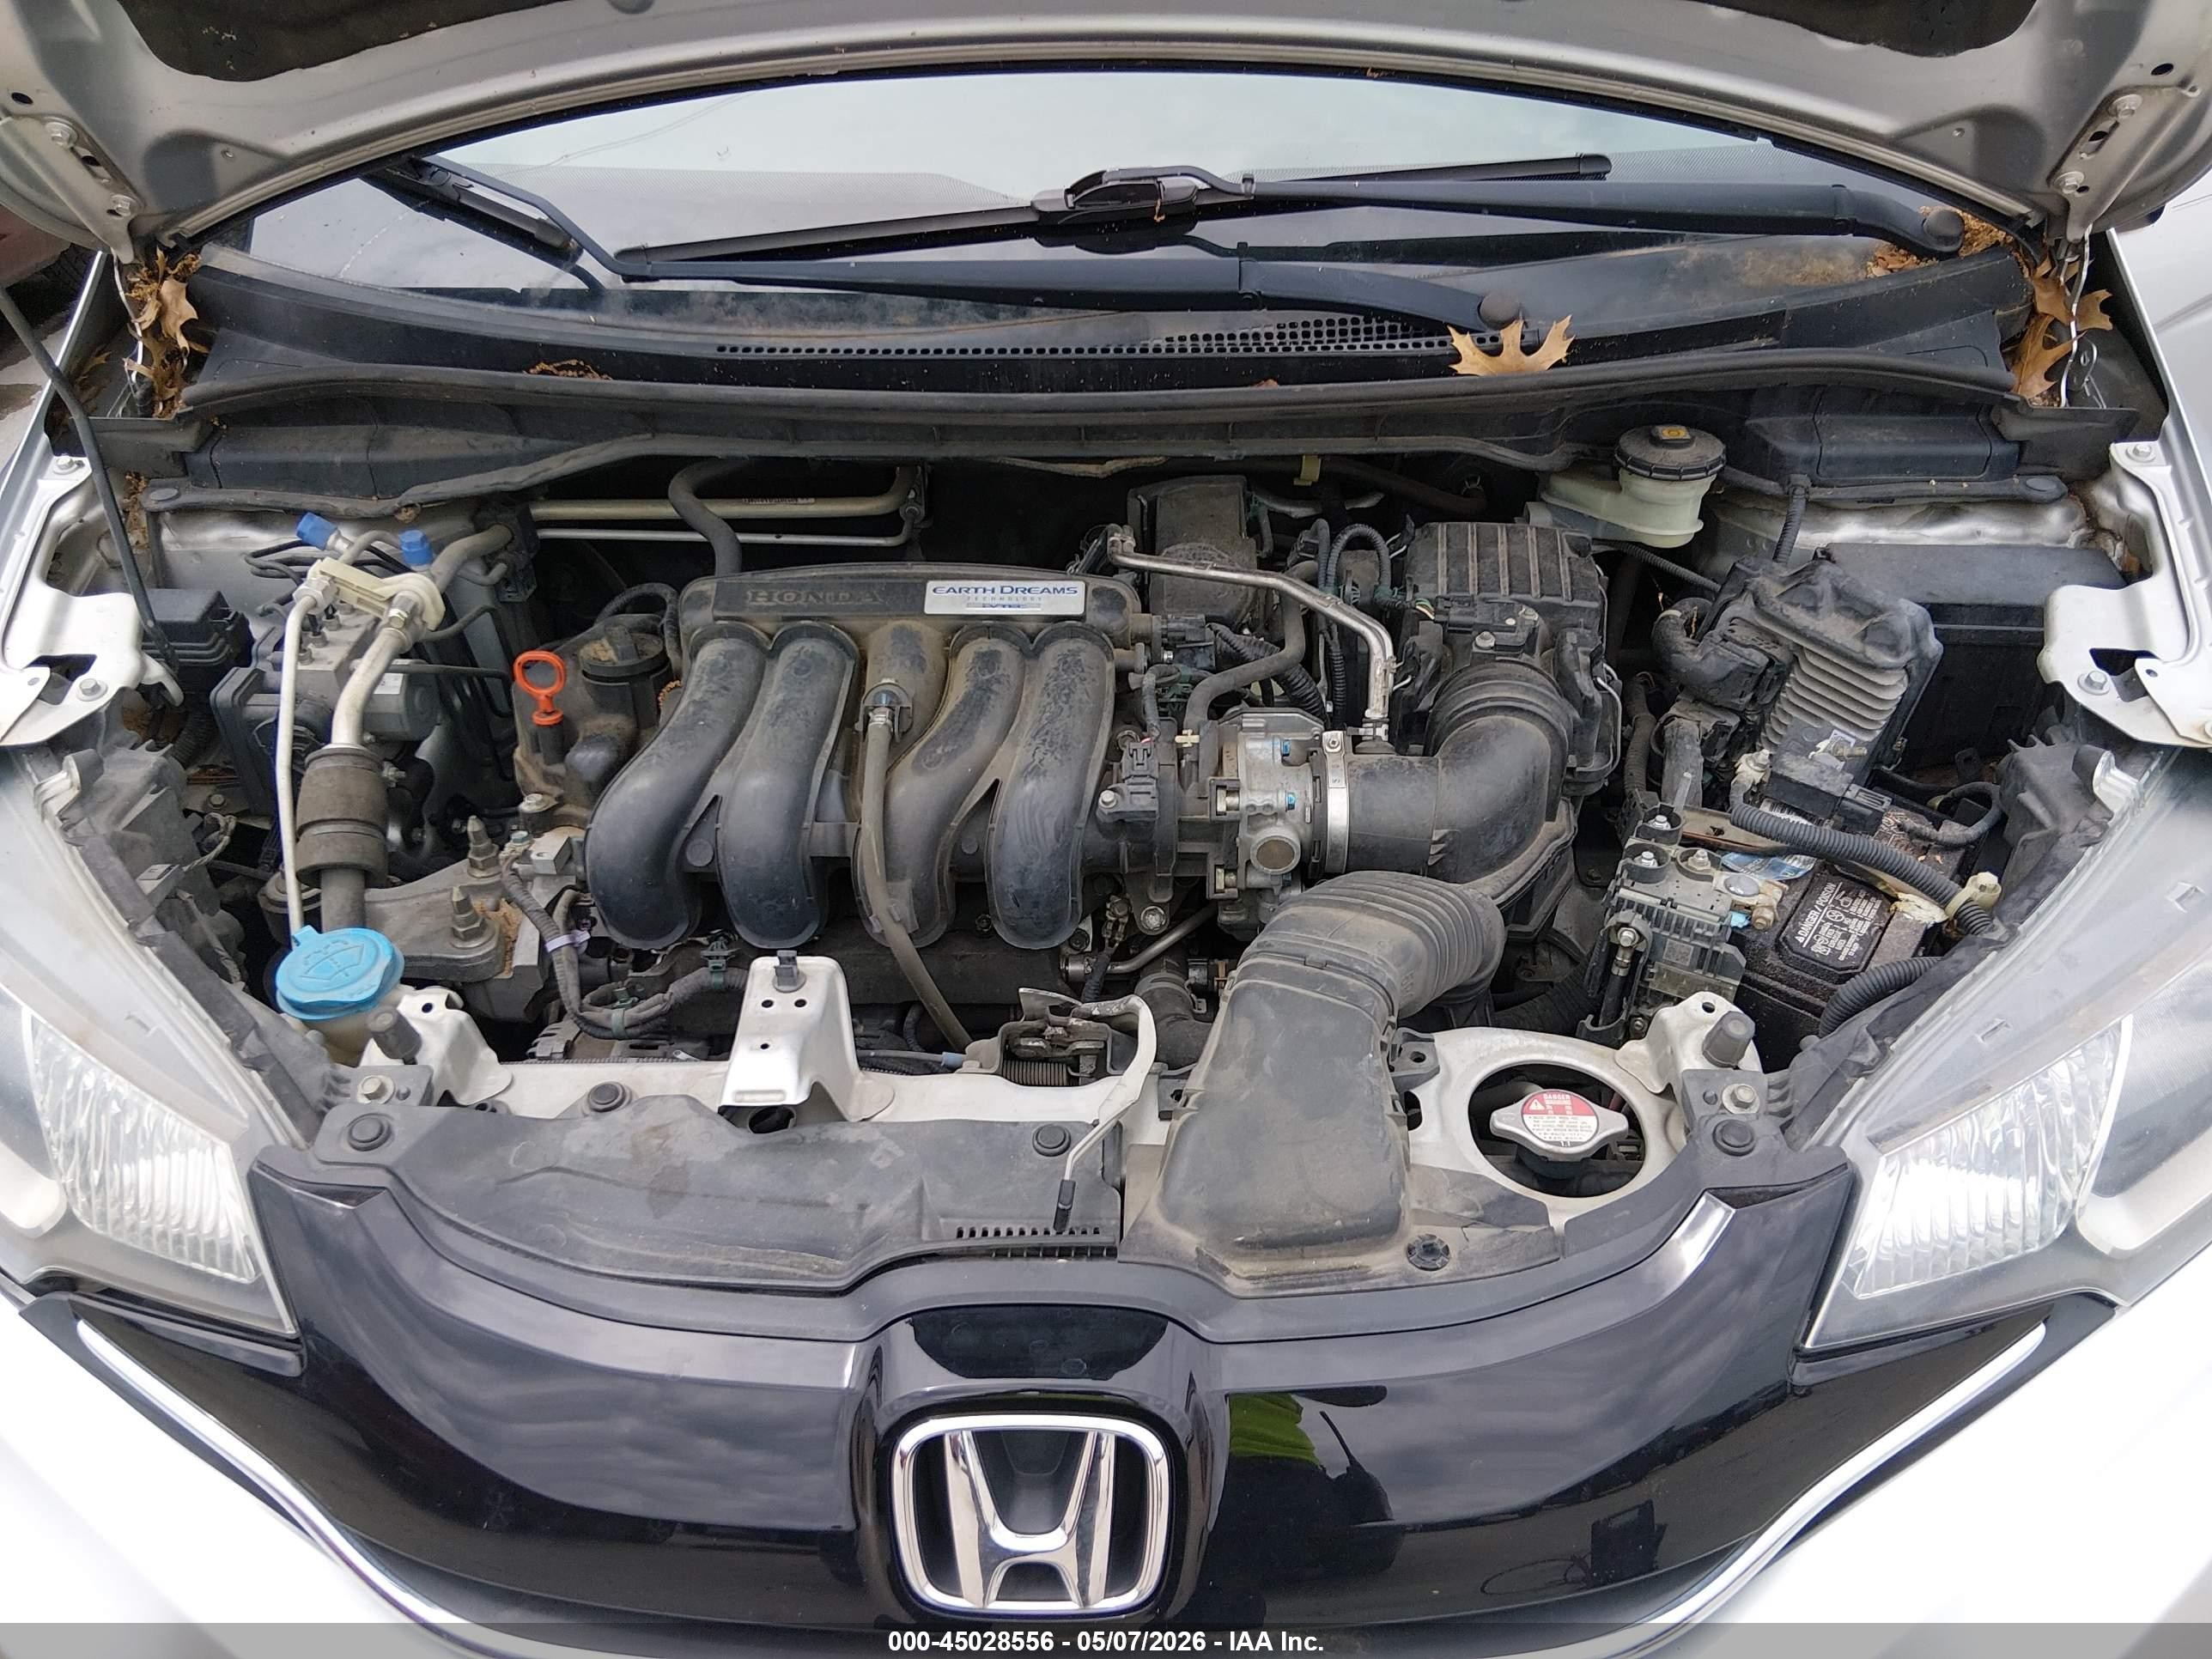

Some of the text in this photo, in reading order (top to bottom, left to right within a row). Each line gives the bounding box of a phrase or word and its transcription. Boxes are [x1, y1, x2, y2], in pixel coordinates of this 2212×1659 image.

[746, 589, 884, 605] HONDA
[933, 585, 1079, 595] EARTH DREAMS
[1800, 908, 1820, 937] DANGER
[1816, 882, 1837, 908] POISON
